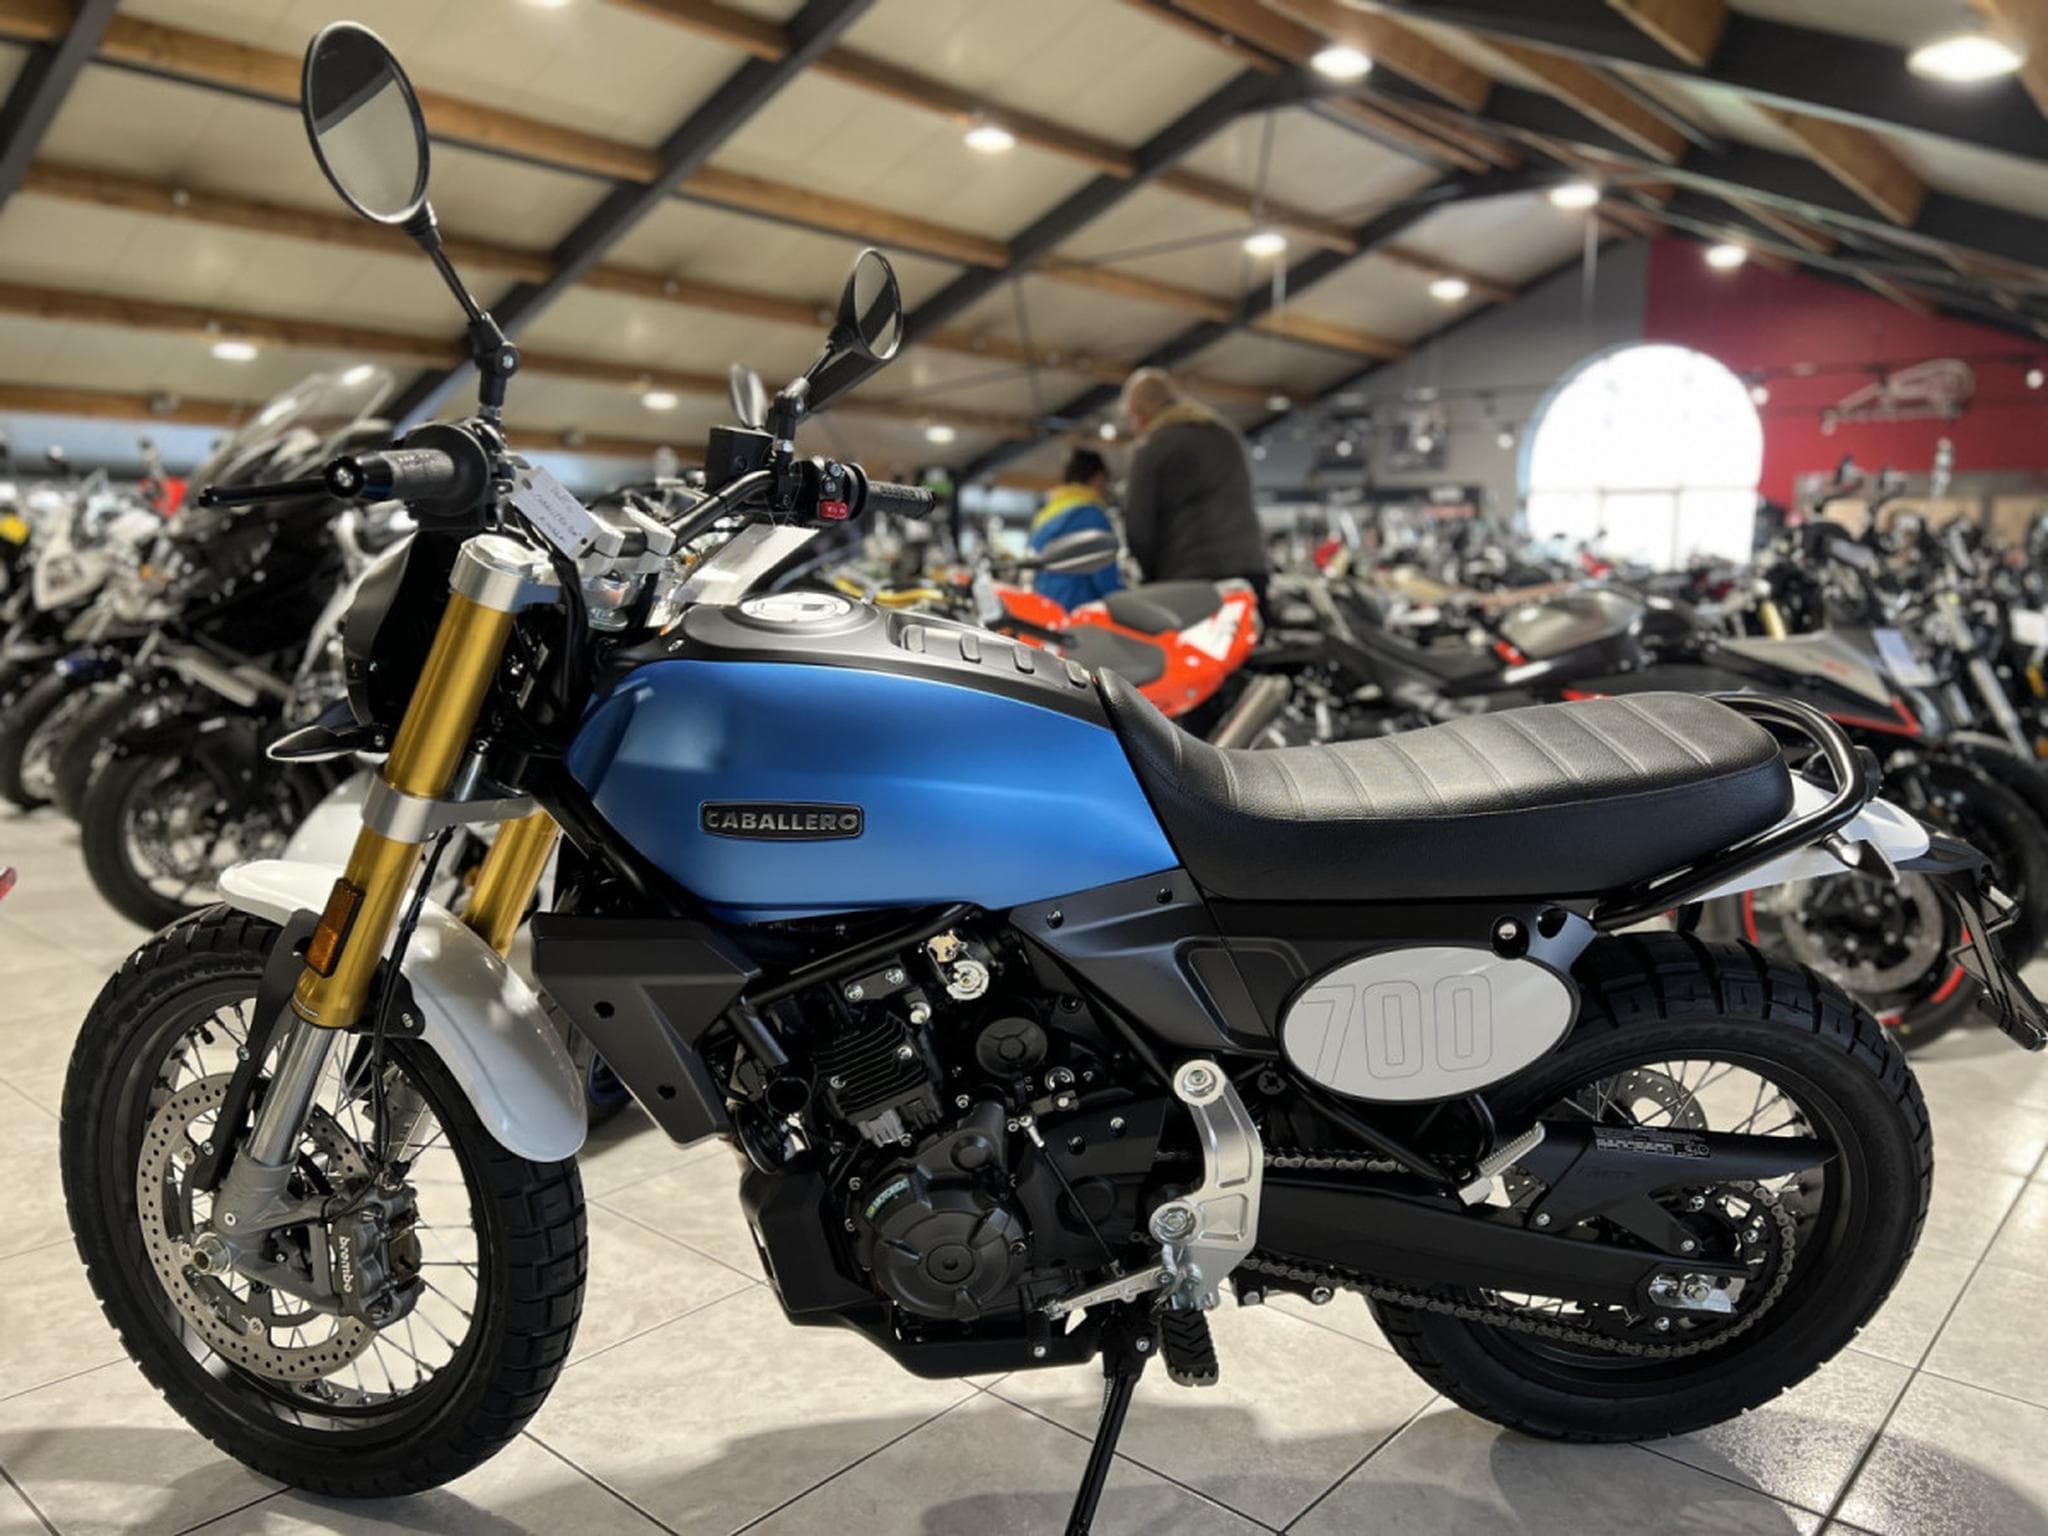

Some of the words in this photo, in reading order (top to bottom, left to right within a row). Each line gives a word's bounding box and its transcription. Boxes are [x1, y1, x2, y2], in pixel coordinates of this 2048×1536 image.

[705, 810, 858, 830] CABALLERO
[1301, 973, 1493, 1086] 700
[339, 1236, 353, 1292] brembo
